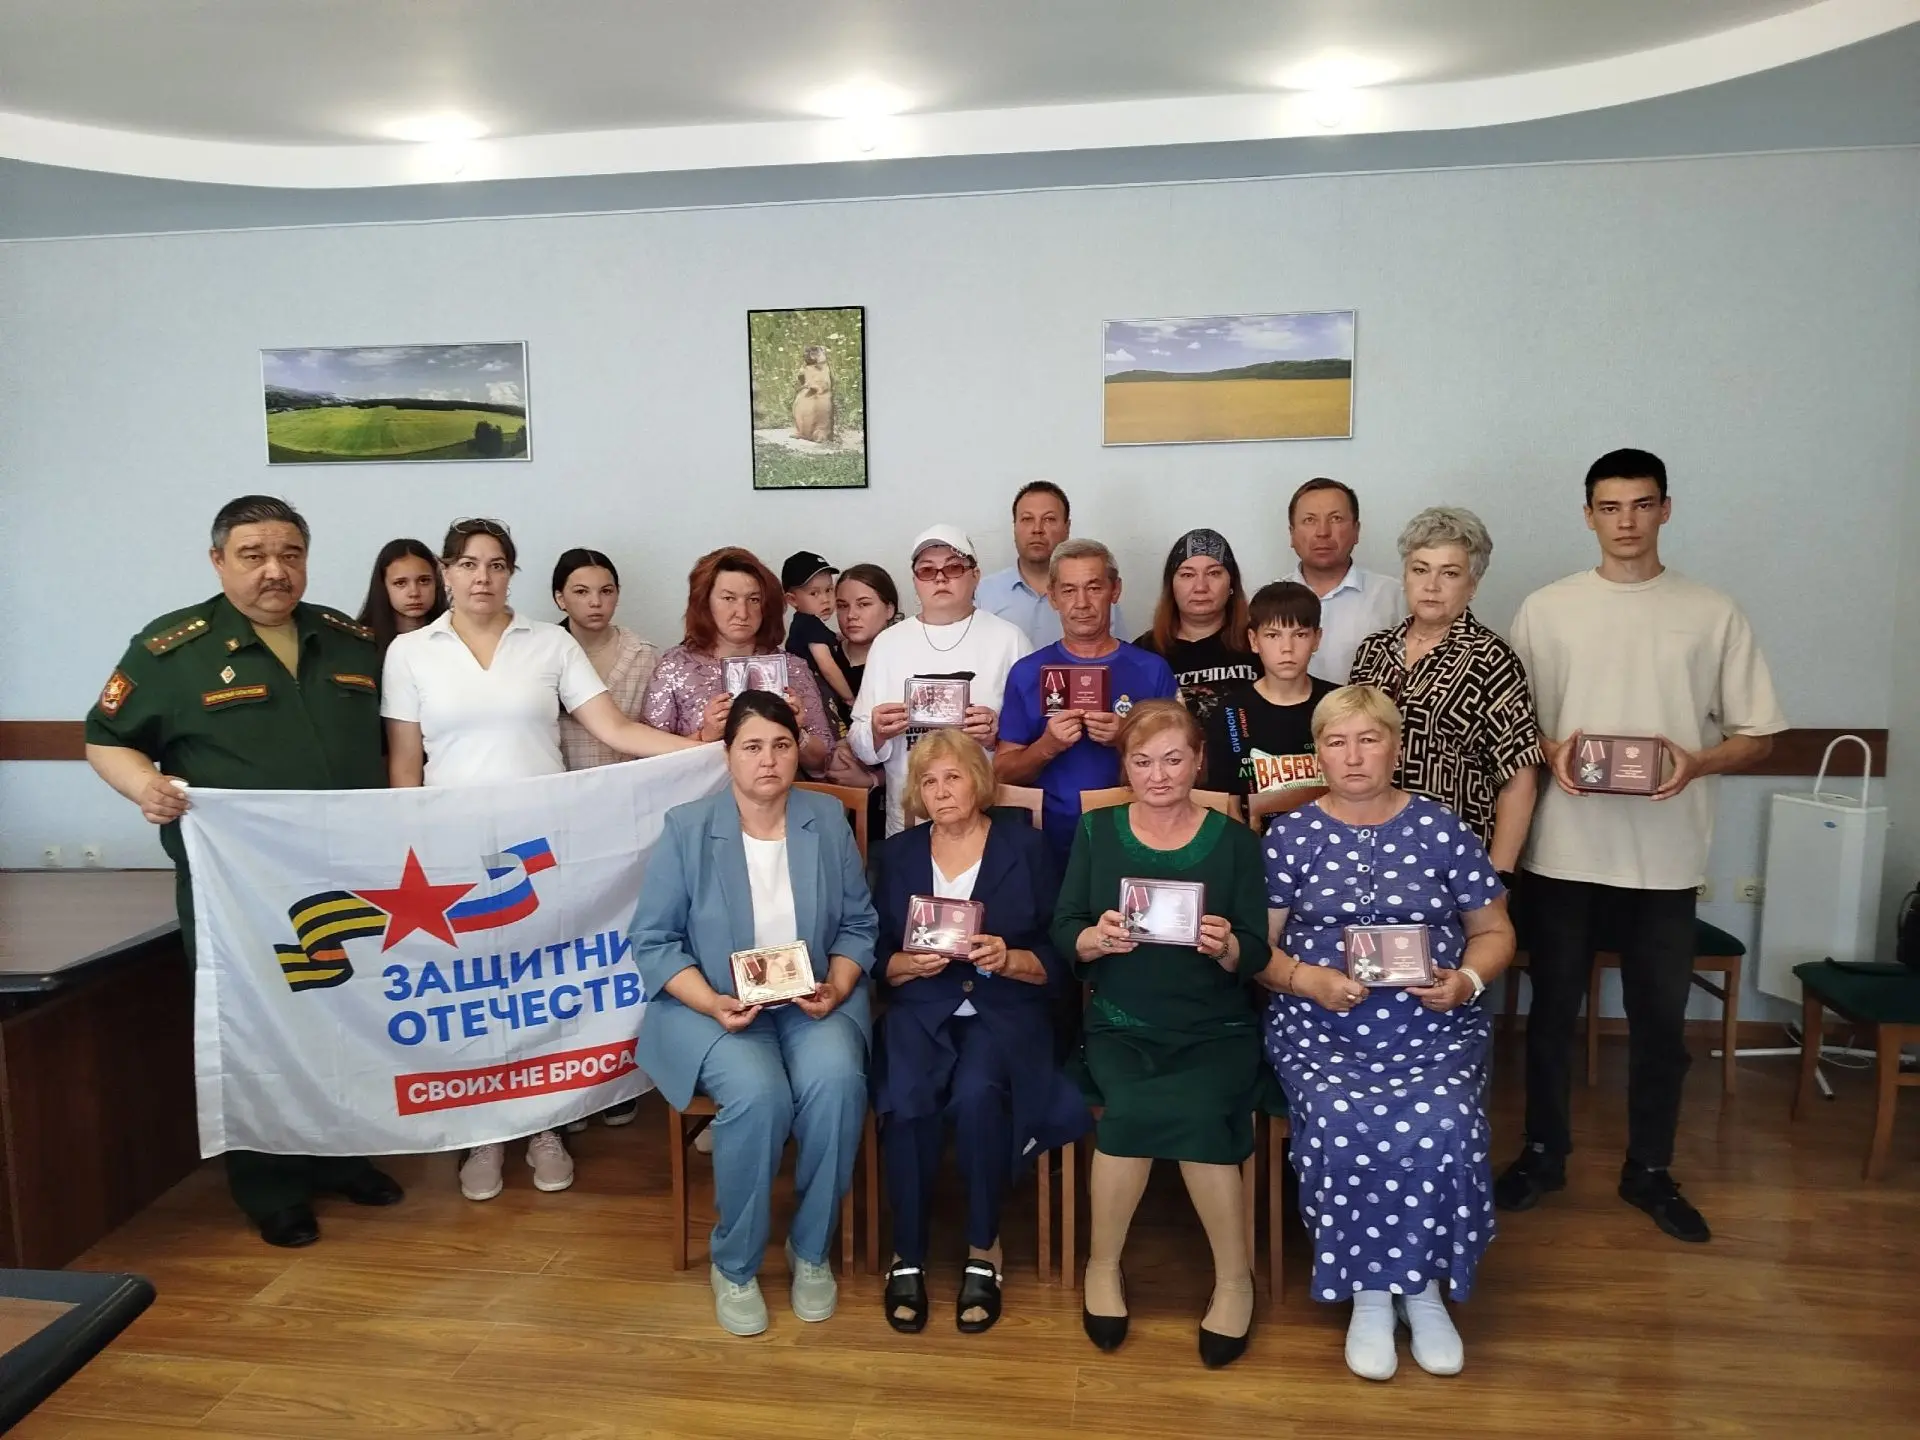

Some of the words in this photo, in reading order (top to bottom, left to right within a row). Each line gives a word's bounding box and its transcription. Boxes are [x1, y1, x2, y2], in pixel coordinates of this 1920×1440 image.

[1225, 707, 1241, 753] GIVENCHY
[388, 972, 648, 1046] ОТЕЧЕСТВ
[407, 1074, 505, 1104] СВОИХ
[509, 1065, 545, 1090] НЕ
[549, 1049, 635, 1083] БРОСА
